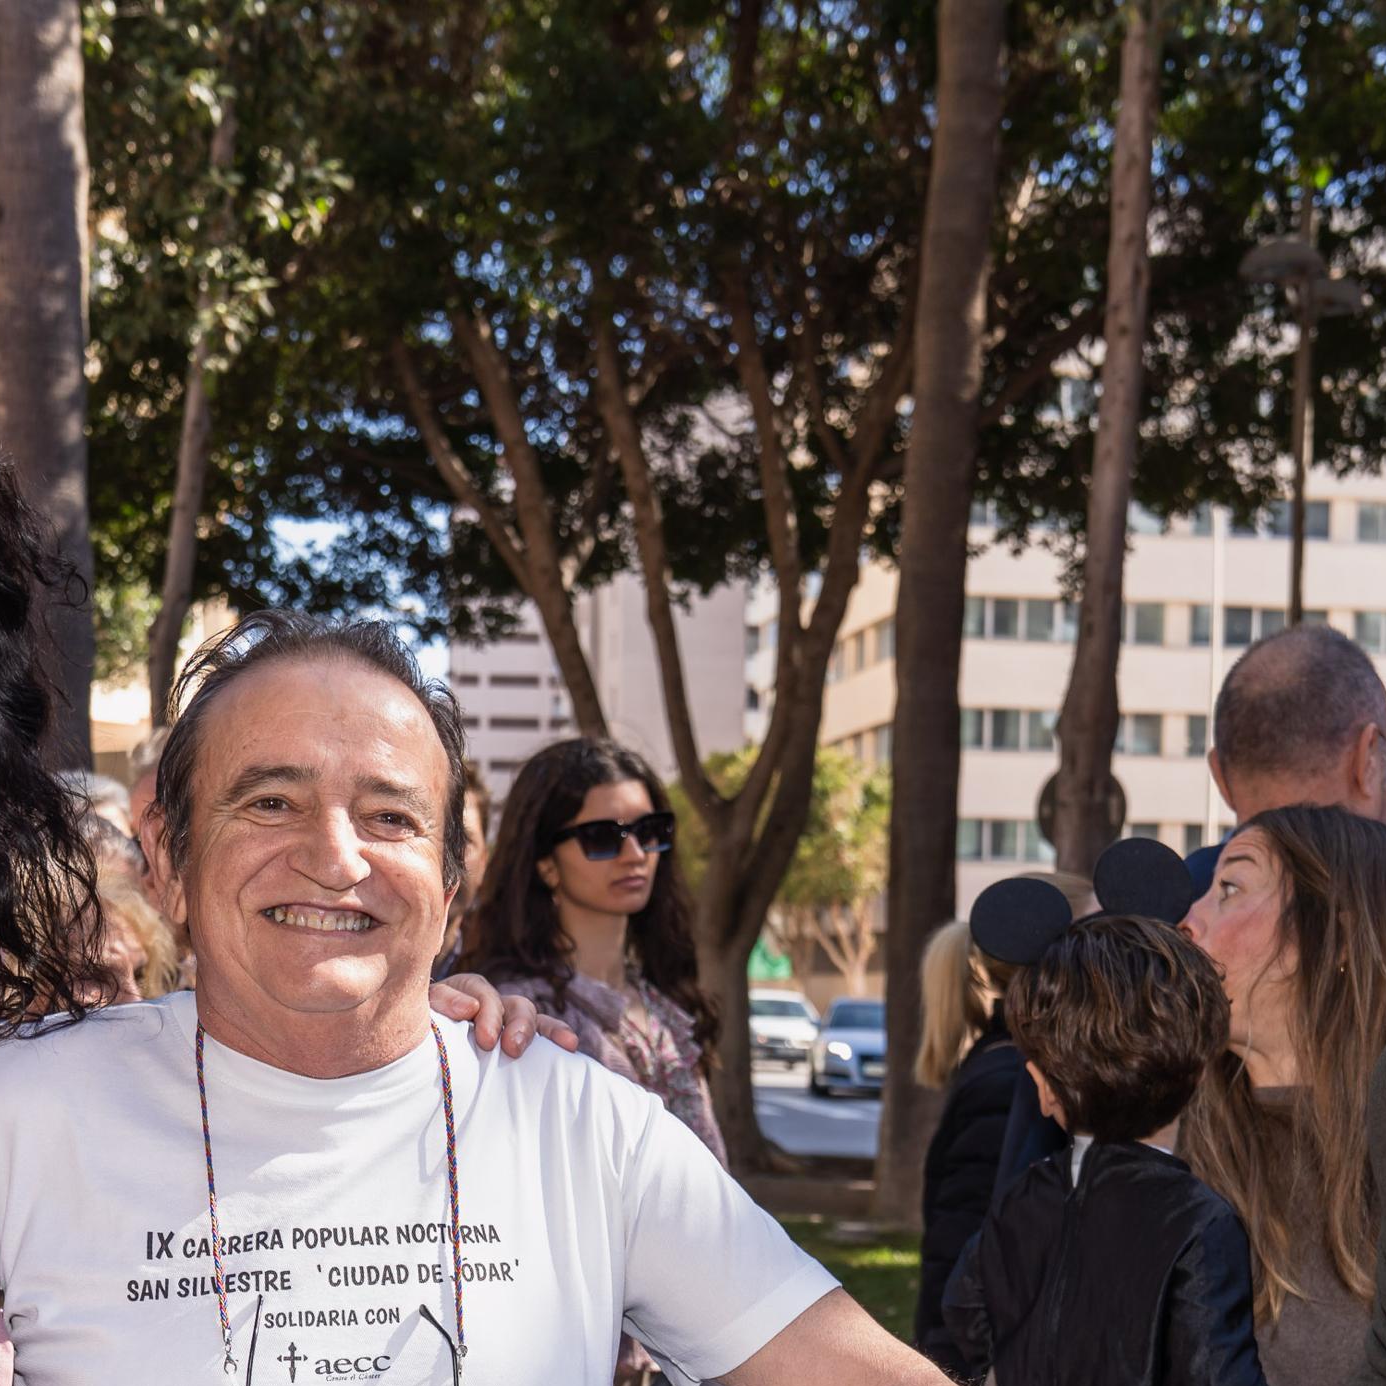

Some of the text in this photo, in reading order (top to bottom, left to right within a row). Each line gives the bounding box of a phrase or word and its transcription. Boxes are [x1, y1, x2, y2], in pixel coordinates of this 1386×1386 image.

[146, 1231, 175, 1260] IX
[292, 1225, 390, 1250] POPULAR
[127, 1278, 169, 1301] SAN
[418, 1263, 444, 1284] DE
[449, 1257, 519, 1282] ÓDAR'
[264, 1307, 400, 1329] SOLIDARIA CON
[315, 1355, 391, 1375] aecc
